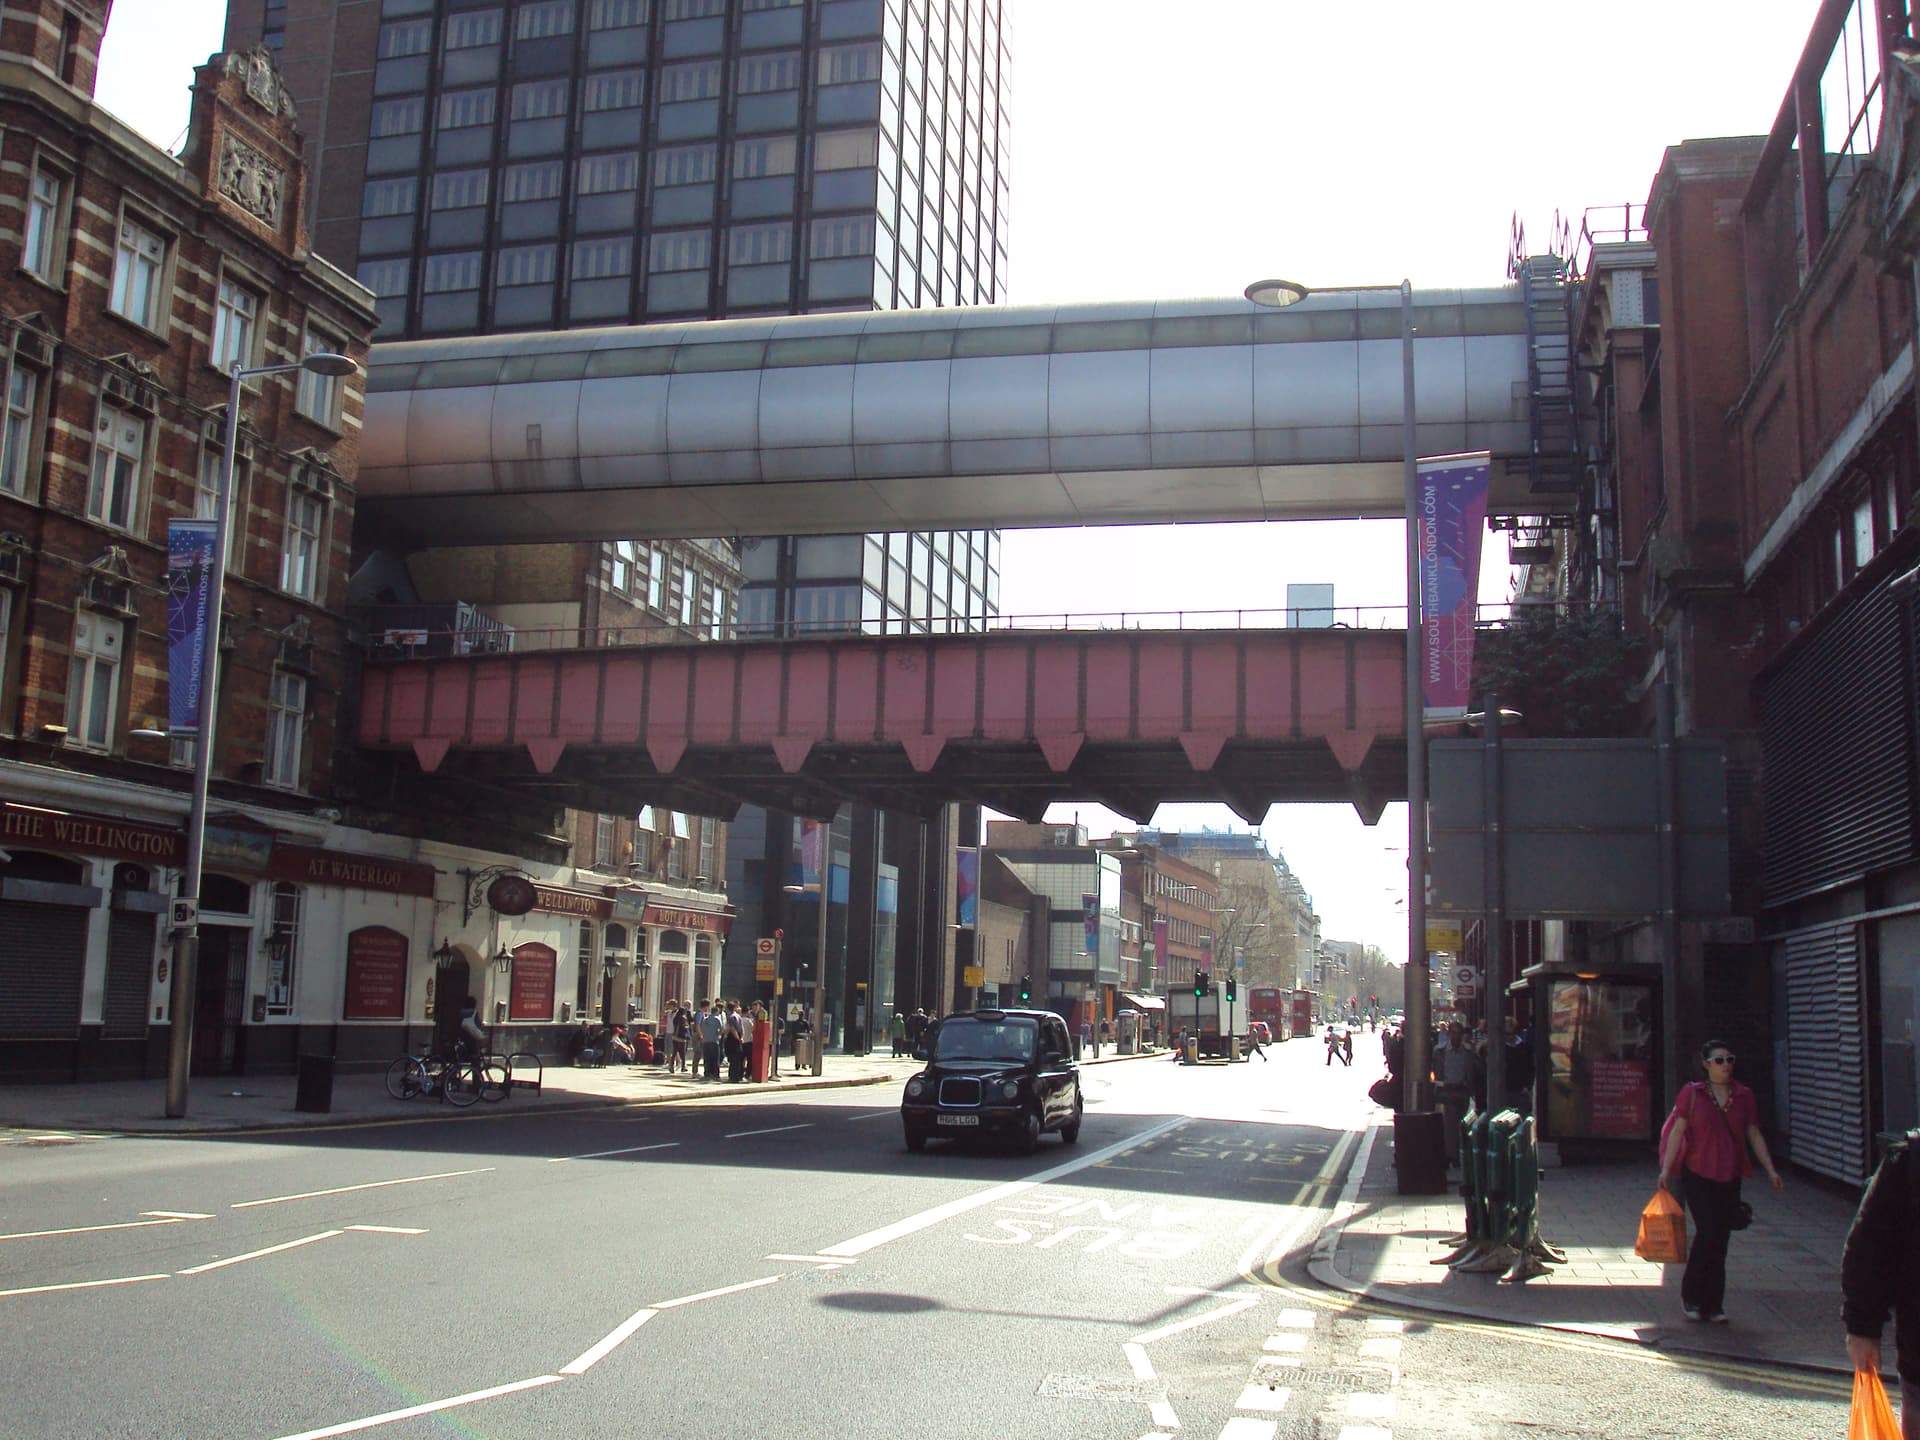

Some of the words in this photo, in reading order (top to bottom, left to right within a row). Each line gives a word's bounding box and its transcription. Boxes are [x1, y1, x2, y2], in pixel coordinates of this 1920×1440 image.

[1424, 485, 1441, 684] WWW.SOUTHBANKLONDON.COM
[187, 543, 214, 709] WWW.SOUTHBANKLONDON.COM
[2, 811, 44, 838] THE
[53, 819, 176, 856] WELLINGTON
[308, 857, 328, 877] AT
[331, 861, 401, 888] WATERLOO
[537, 891, 598, 913] WELLINGTON
[1170, 1146, 1305, 1166] BUS
[962, 1217, 1202, 1260] BUS
